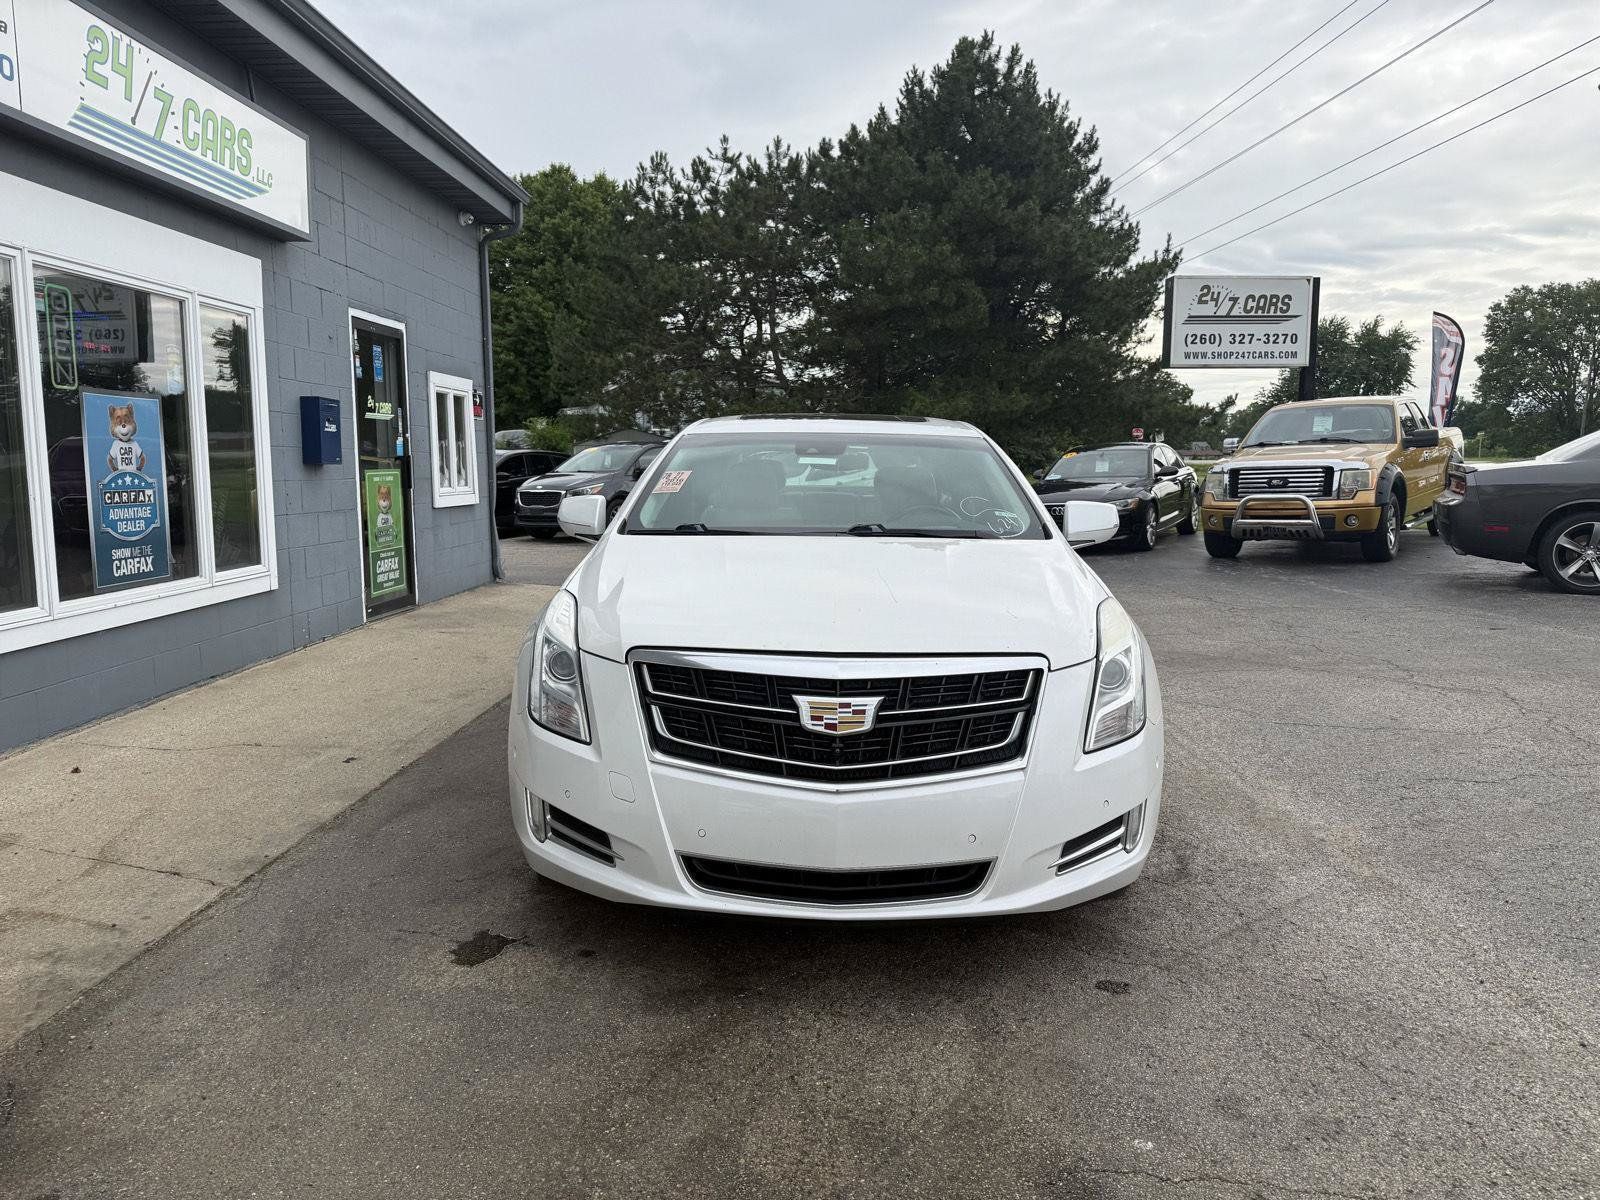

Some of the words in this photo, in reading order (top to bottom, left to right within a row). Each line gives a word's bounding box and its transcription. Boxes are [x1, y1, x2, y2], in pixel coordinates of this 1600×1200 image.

[1197, 284, 1240, 317] 24/7
[1243, 294, 1292, 314] CARS
[51, 291, 74, 384] OPEN
[1184, 333, 1222, 347] (260)
[1229, 333, 1298, 345] 327-3270
[1184, 350, 1298, 360] WWW.SHOP247CARS.COM
[119, 446, 133, 458] CAR
[121, 457, 134, 467] FOX
[109, 506, 152, 520] ADVANTAGE
[117, 519, 146, 533] DEALER
[112, 547, 132, 559] SHOW
[113, 555, 154, 577] CARFAX
[376, 557, 399, 574] CARFAX
